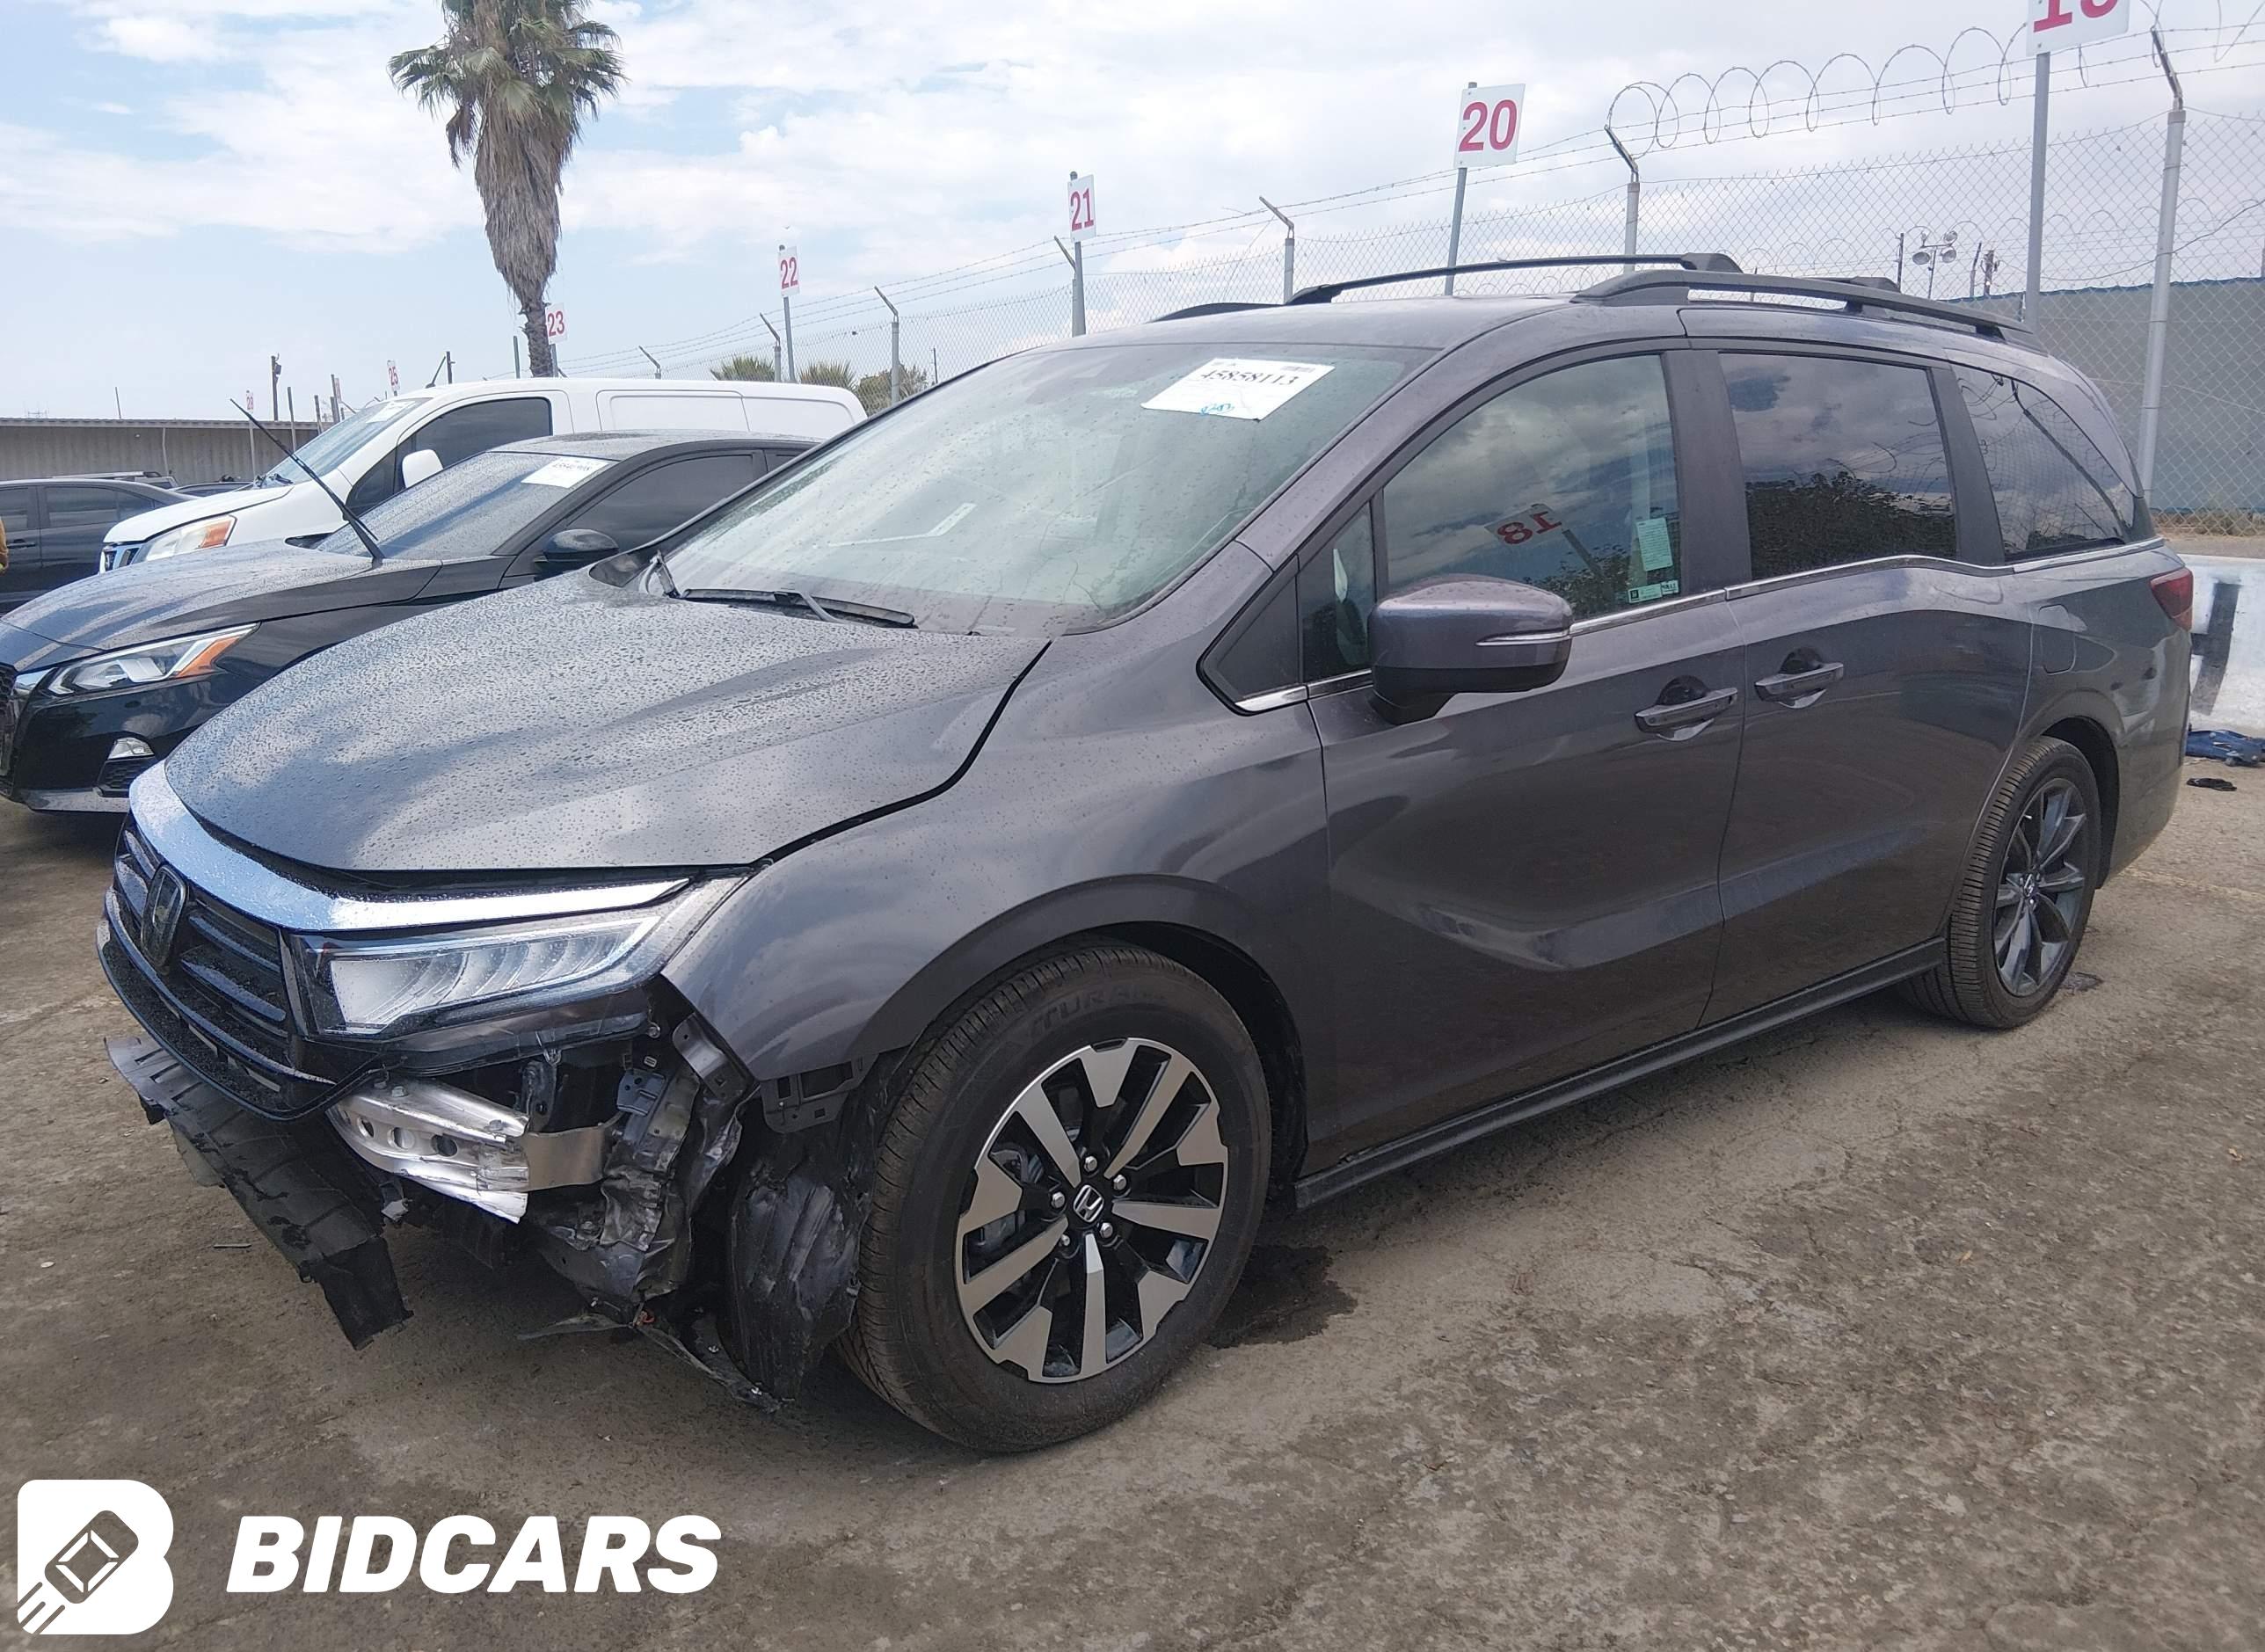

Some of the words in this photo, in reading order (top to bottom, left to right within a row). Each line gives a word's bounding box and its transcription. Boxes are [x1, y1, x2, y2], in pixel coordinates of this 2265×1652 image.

[1458, 98, 1518, 152] 20
[1070, 187, 1094, 231] 21
[780, 256, 798, 289] 22
[547, 310, 565, 337] 23
[389, 366, 398, 386] 25
[1200, 369, 1300, 385] 45858113
